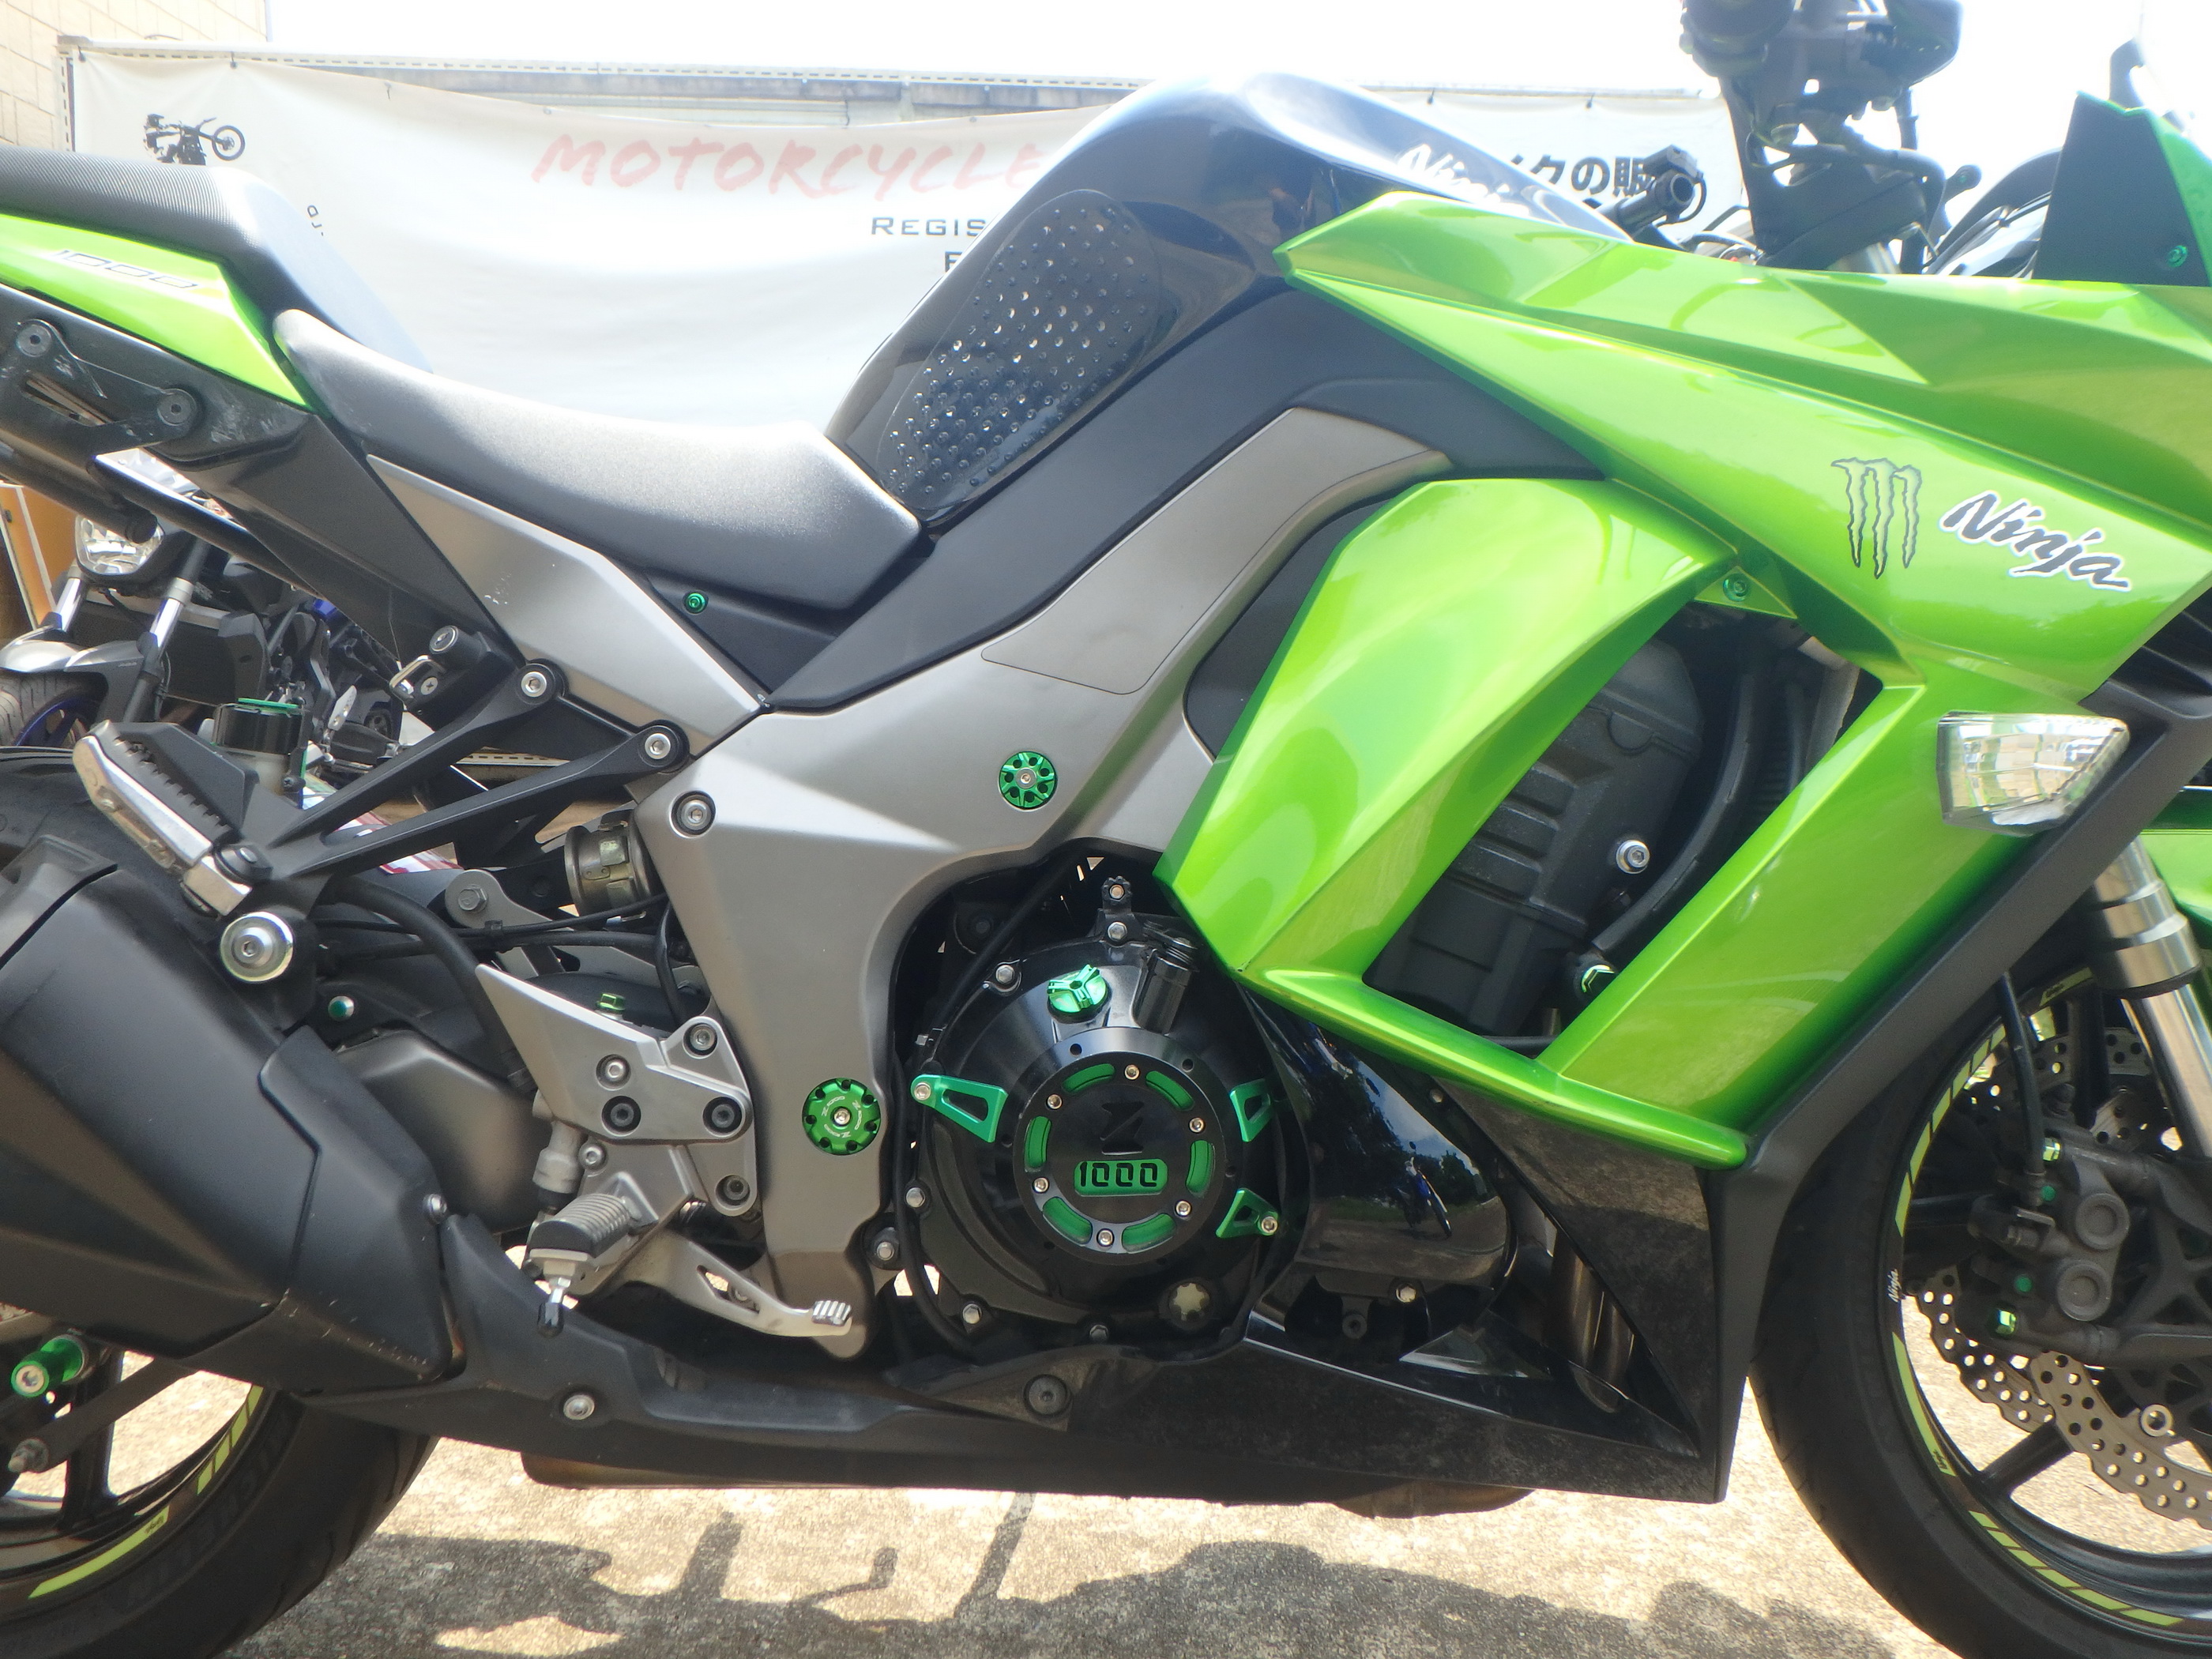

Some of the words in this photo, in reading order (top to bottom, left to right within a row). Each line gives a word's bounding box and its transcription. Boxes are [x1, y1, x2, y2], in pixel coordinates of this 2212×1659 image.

[530, 134, 1045, 201] MOTORCYCLE
[1939, 491, 2131, 591] Ninja
[1079, 1161, 1158, 1187] 1000
